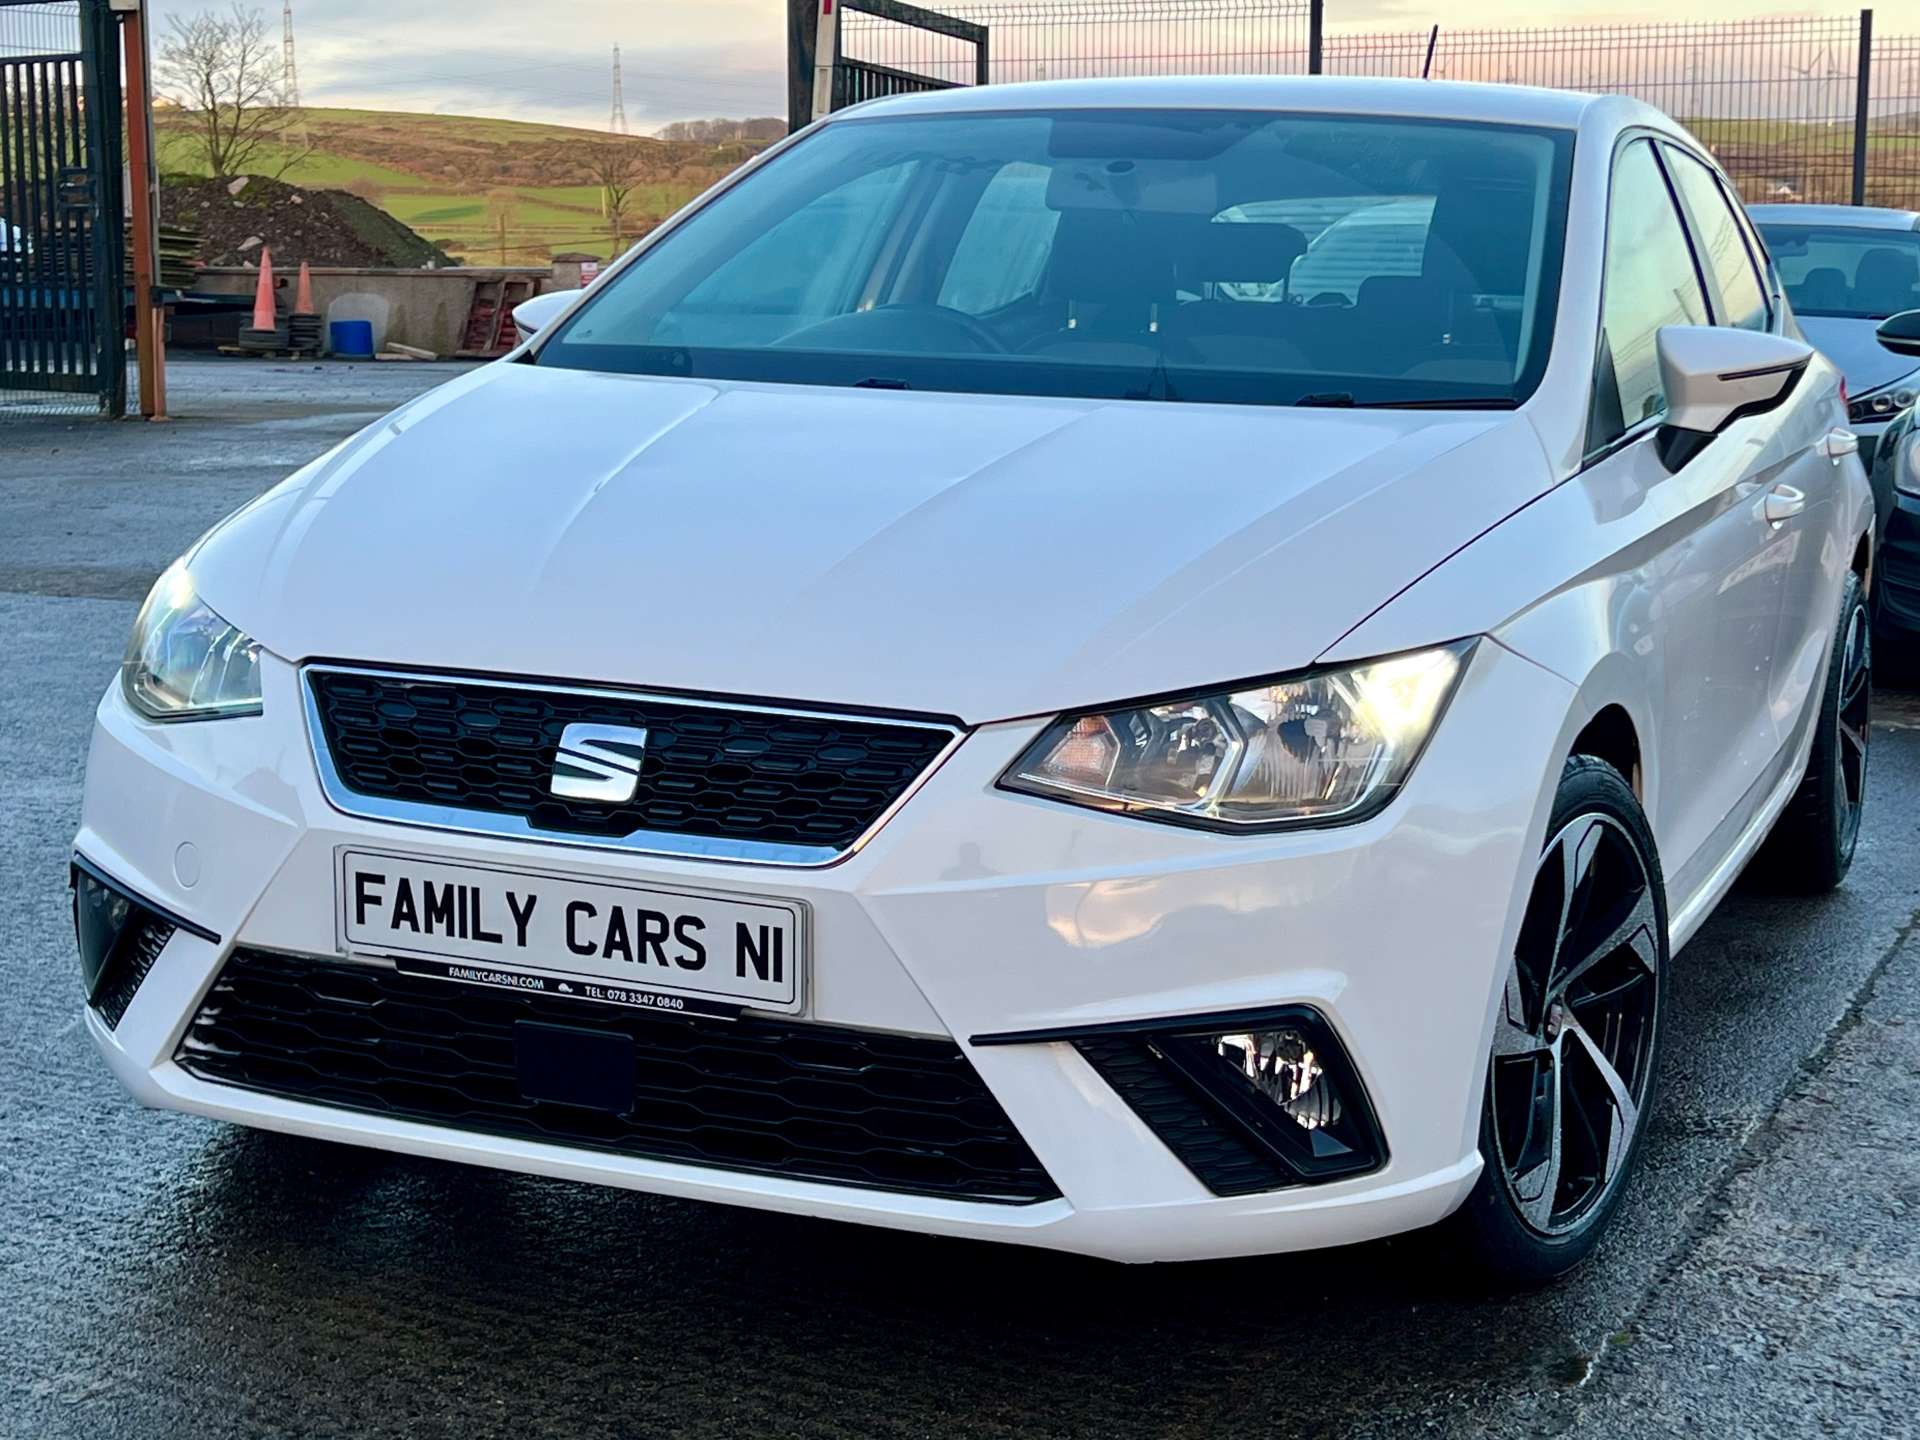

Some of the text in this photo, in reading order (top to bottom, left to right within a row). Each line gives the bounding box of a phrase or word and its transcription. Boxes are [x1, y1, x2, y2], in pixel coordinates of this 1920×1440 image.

[355, 871, 783, 983] FAMILY CARS NI
[448, 966, 545, 990] FAMILYCARSNI.COM
[607, 989, 627, 1002] 078
[628, 992, 655, 1006] 3347
[656, 996, 684, 1010] 0840
